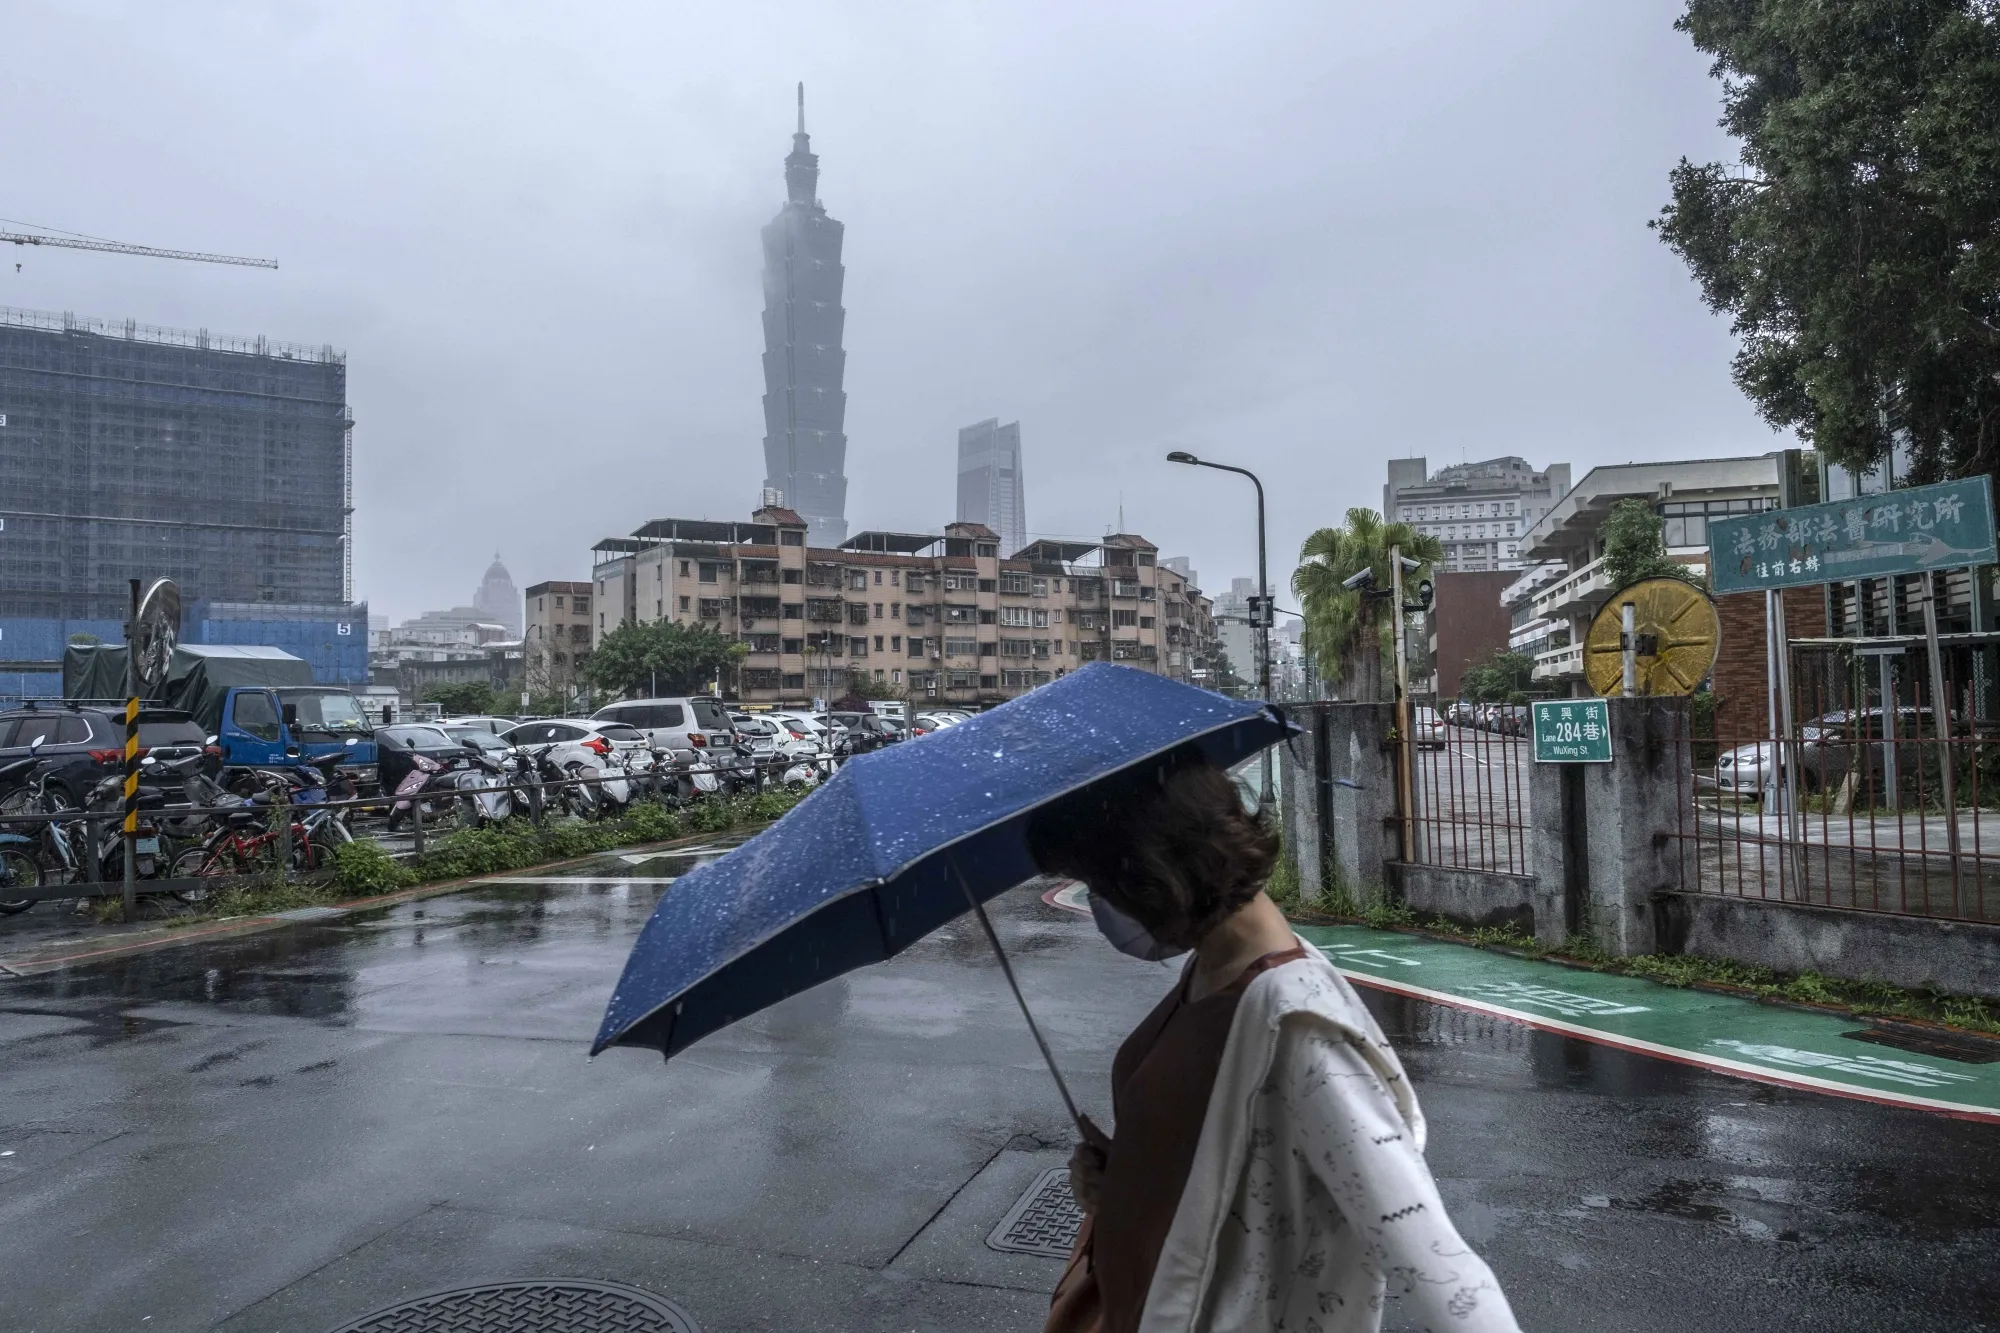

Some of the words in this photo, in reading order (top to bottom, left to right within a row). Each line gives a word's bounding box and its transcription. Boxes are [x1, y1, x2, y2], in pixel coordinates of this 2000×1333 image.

[1731, 494, 1965, 556] 法務部法醫研究所
[1755, 555, 1821, 579] 往前右轉
[340, 624, 348, 634] 5
[1541, 707, 1598, 721] 吳興街
[1542, 733, 1556, 742] Lane
